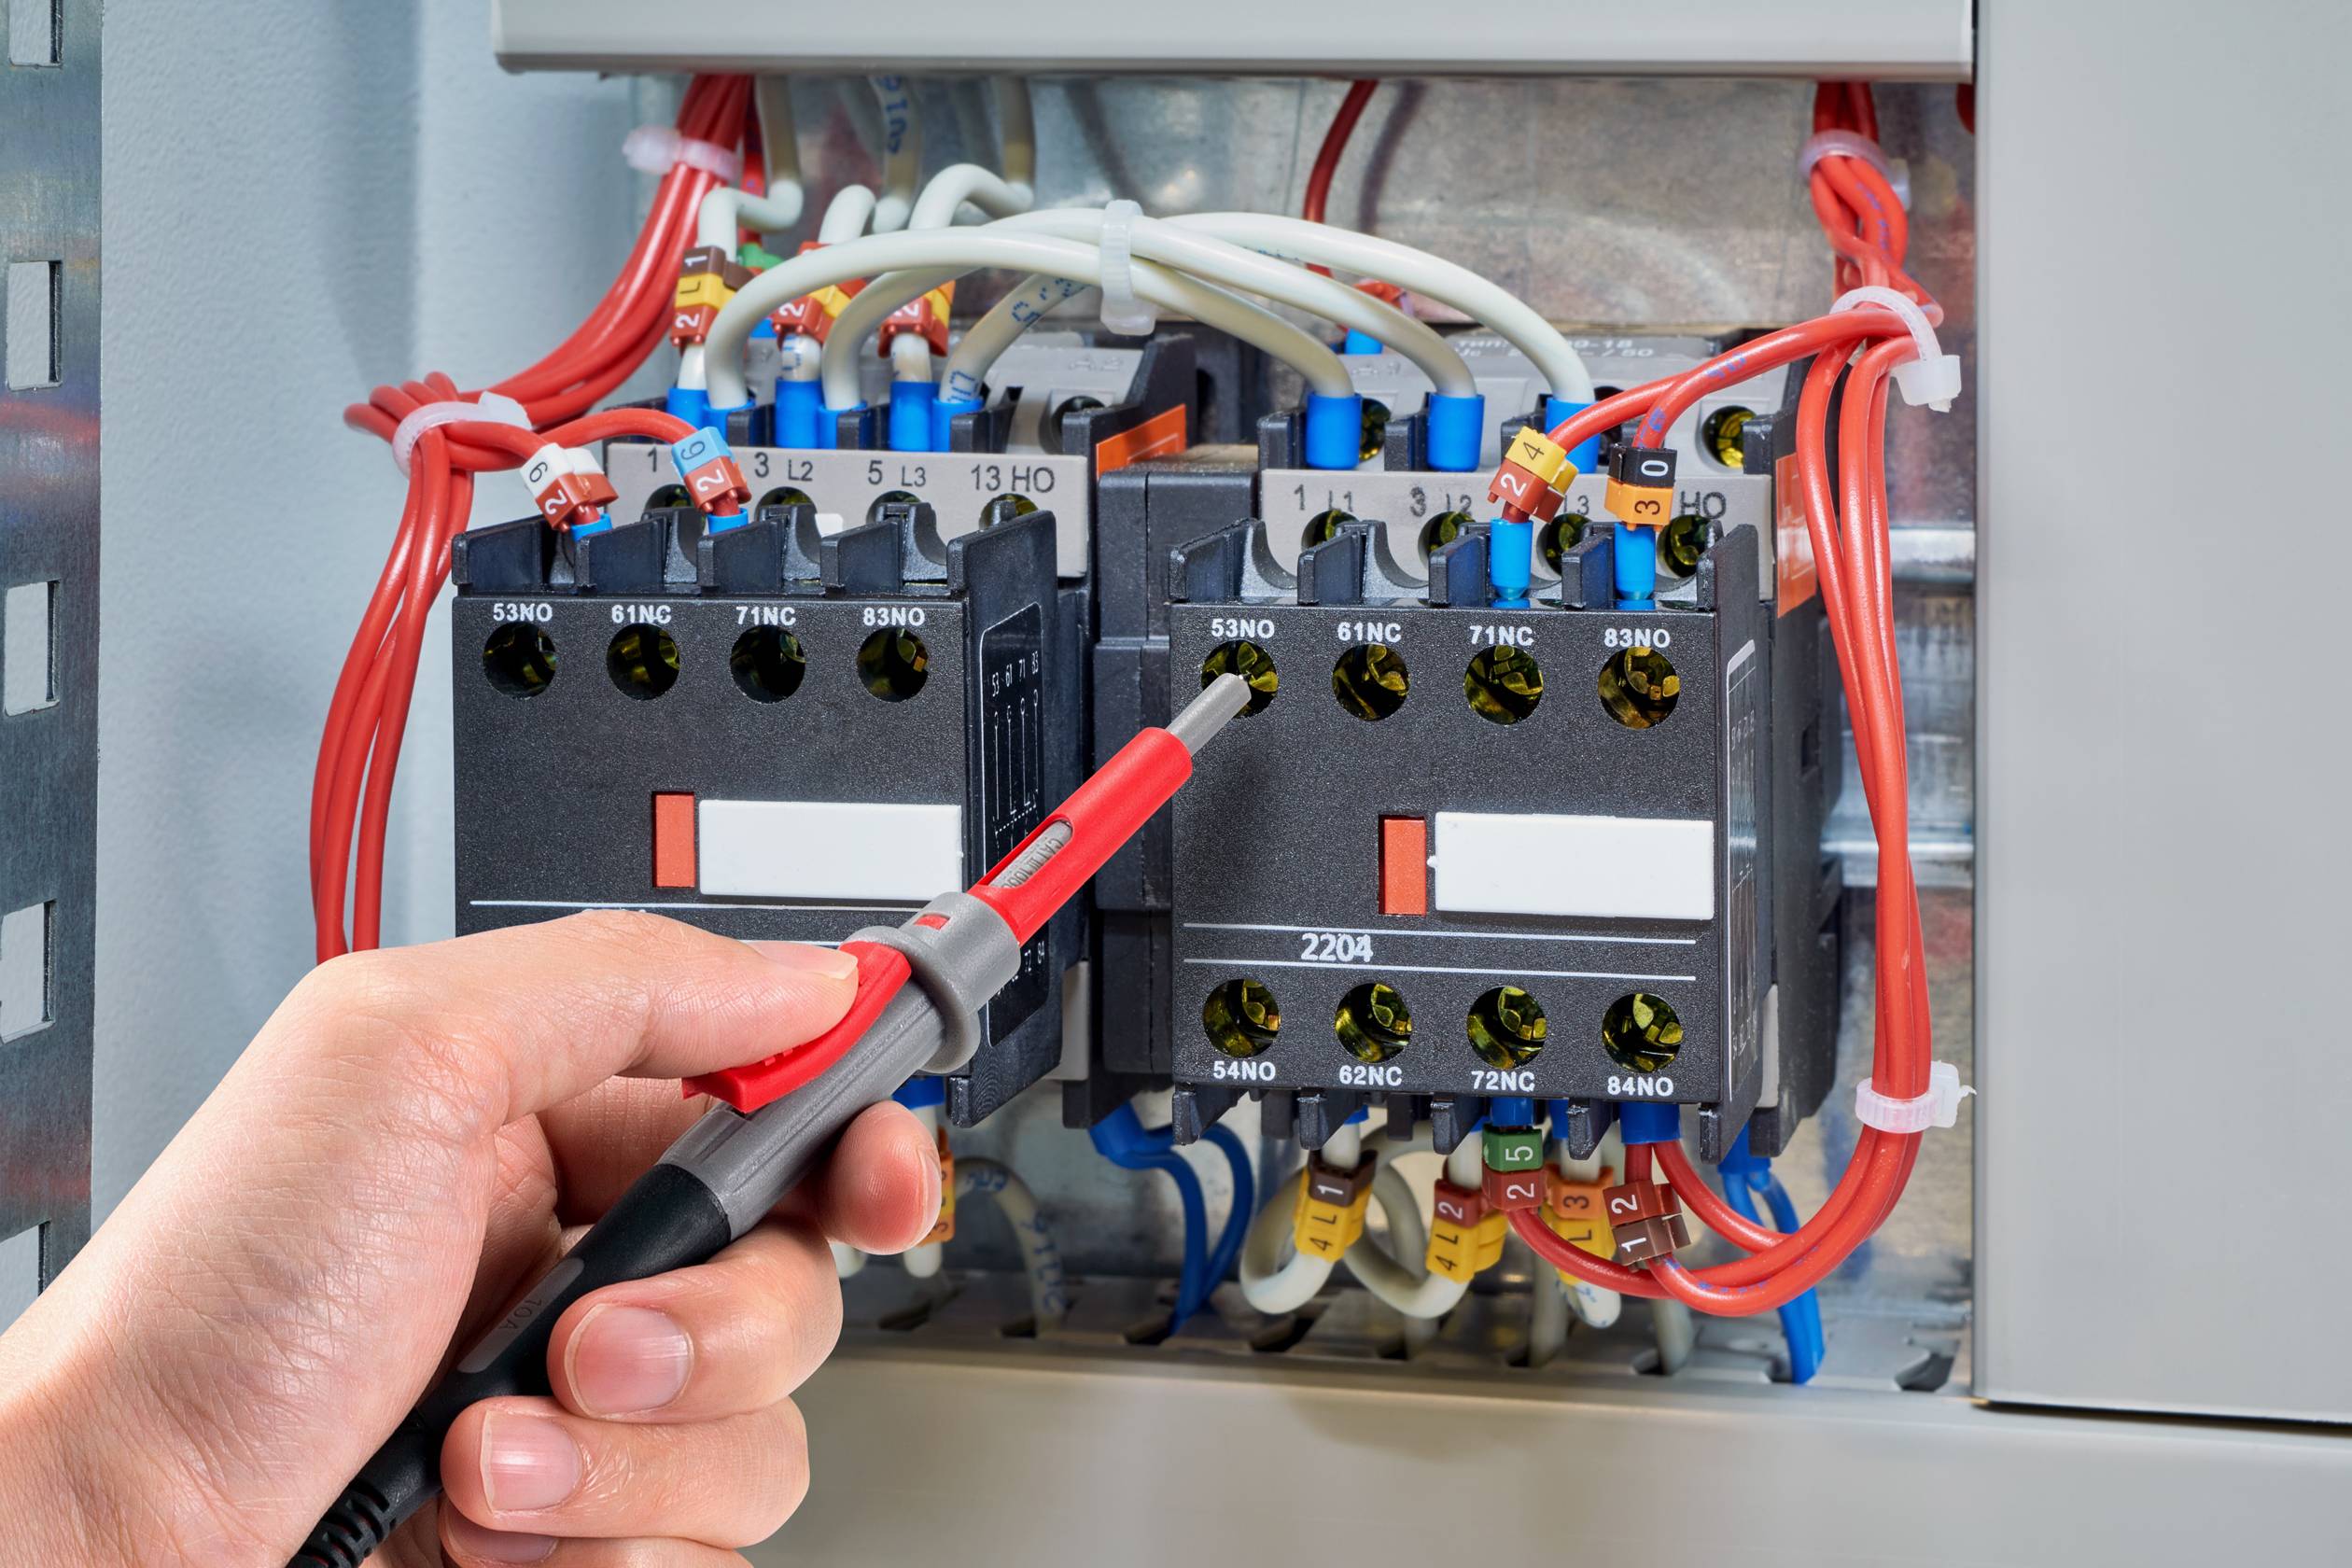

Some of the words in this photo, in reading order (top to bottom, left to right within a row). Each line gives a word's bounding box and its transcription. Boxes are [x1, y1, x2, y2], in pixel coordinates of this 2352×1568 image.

[754, 452, 769, 478] 3
[788, 459, 814, 482] L2
[868, 459, 883, 485] 5
[901, 465, 927, 487] L3
[971, 464, 1001, 492] 13
[1011, 465, 1056, 493] HO
[1294, 483, 1306, 511] 1
[1409, 486, 1427, 517] 3
[1680, 490, 1727, 521] HO
[493, 603, 553, 623] 53NO
[611, 605, 672, 624] 61NC
[735, 607, 797, 626] 71NC
[862, 608, 926, 626] 83NO
[1211, 619, 1275, 638] 53NO
[1337, 622, 1401, 643] 61NC
[1469, 625, 1533, 646] 71NC
[1603, 628, 1671, 648] 83NO
[1300, 932, 1374, 963] 2204
[1213, 1061, 1276, 1081] 54NO
[1338, 1065, 1402, 1086] 62NC
[1471, 1071, 1535, 1092] 72NC
[1607, 1076, 1673, 1097] 84NO
